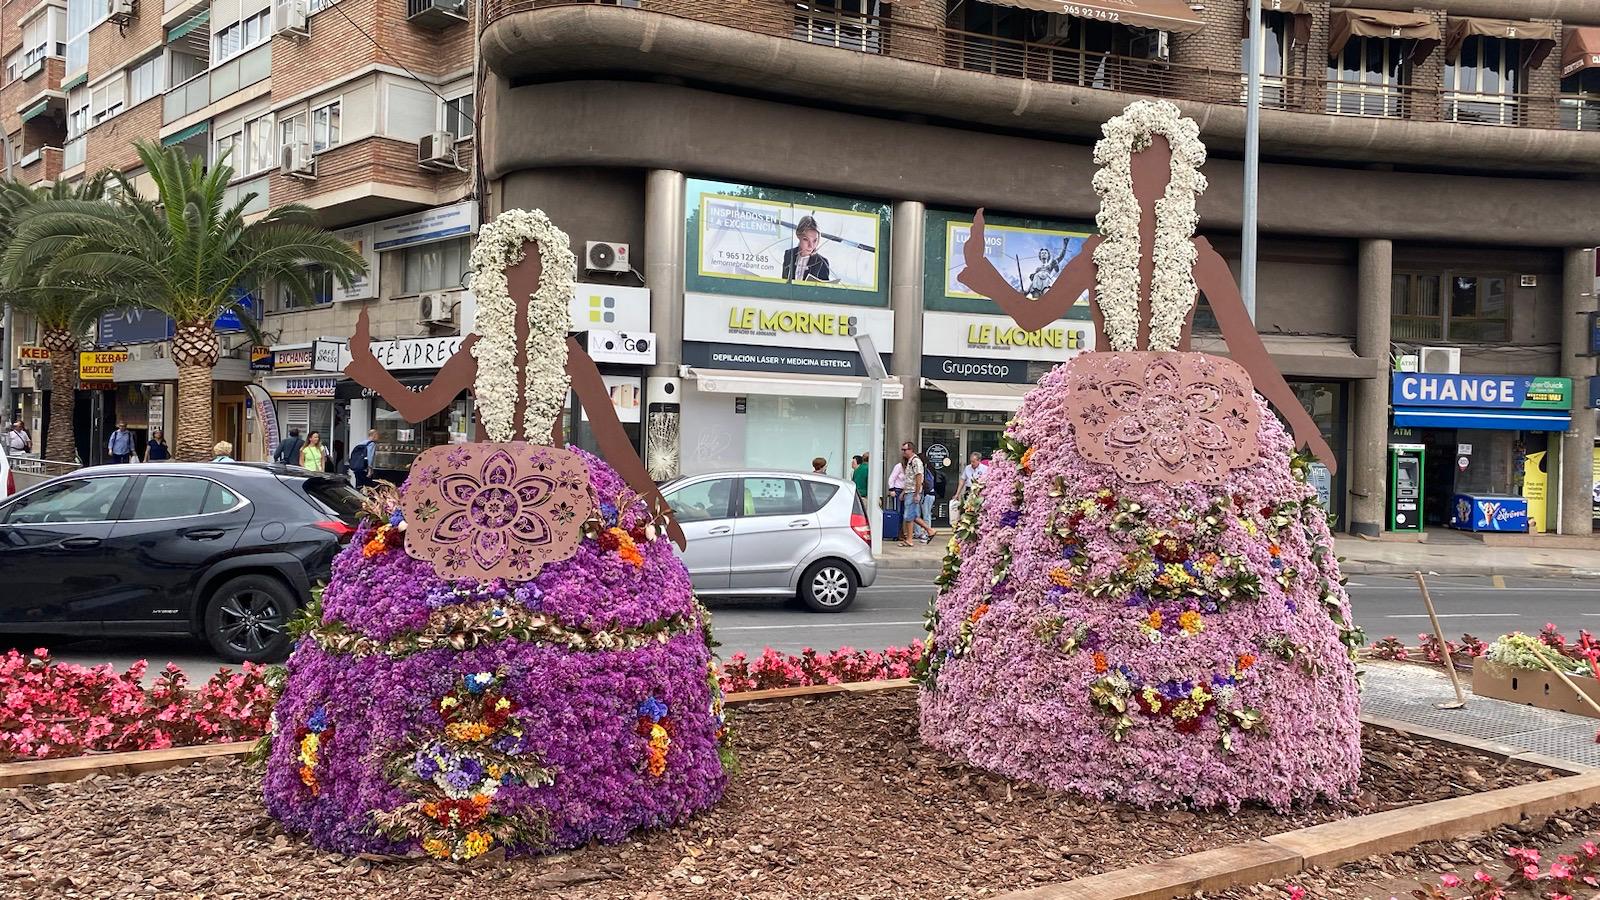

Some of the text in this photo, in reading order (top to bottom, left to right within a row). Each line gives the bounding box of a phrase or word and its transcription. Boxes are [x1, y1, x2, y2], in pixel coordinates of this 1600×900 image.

[1063, 5, 1120, 21] 965 92 74 72
[710, 207, 777, 223] INSPIRADOS EN
[724, 219, 777, 233] EXCELENCIA
[956, 234, 1002, 246] LUMOS
[726, 251, 739, 260] 965
[742, 253, 754, 261] 122
[756, 254, 769, 263] 685
[711, 258, 774, 271] lemornebrabant.com
[729, 307, 834, 335] LE MORNE
[967, 324, 1063, 348] LE MORNE
[95, 353, 128, 363] KEBAP
[280, 351, 312, 364] EXCHANGE
[403, 341, 456, 365] XPRES
[786, 358, 819, 366] MEDICINA
[942, 360, 1009, 377] Grupostop
[1401, 377, 1515, 402] CHANGE
[1393, 428, 1412, 436] ATM
